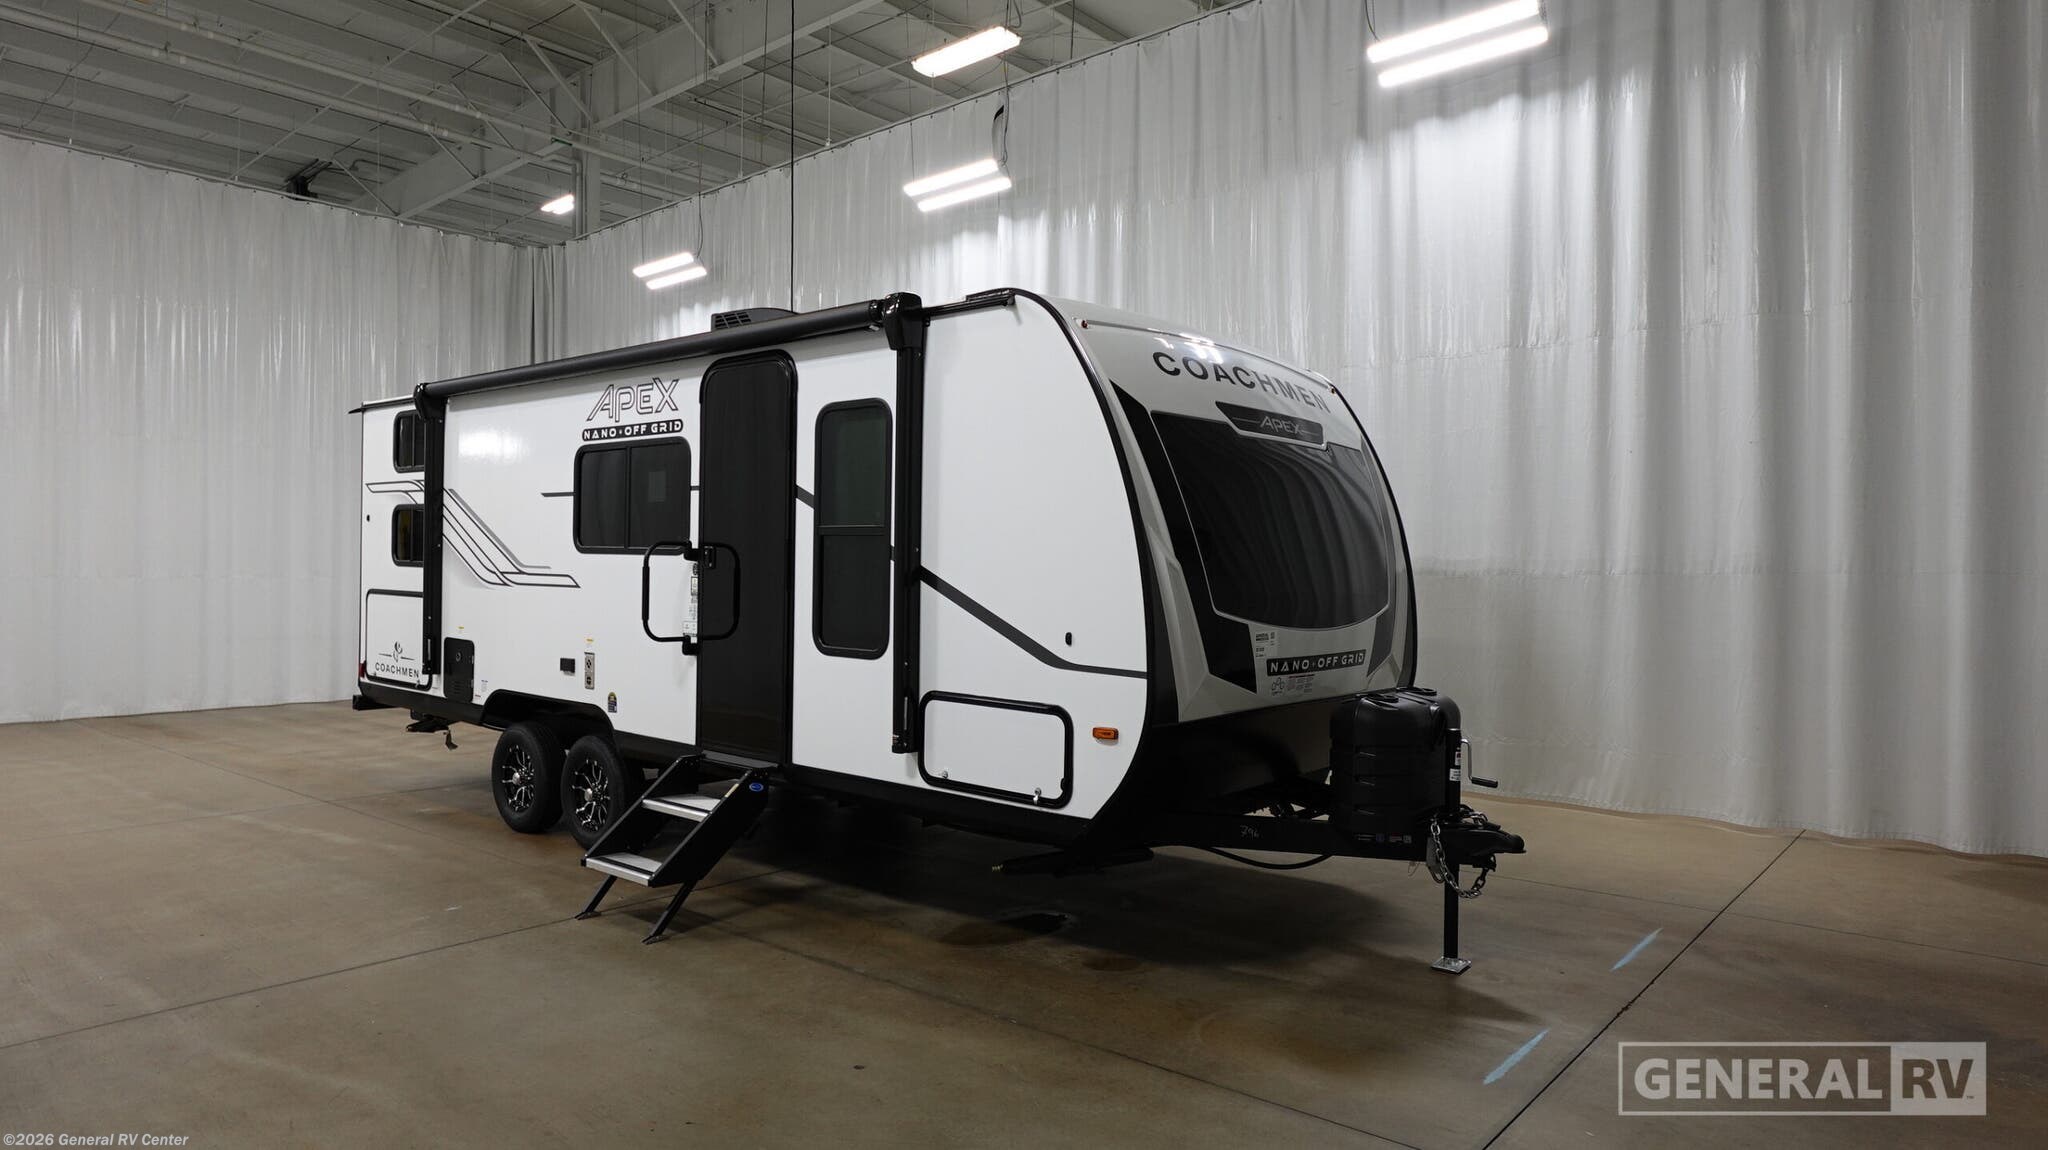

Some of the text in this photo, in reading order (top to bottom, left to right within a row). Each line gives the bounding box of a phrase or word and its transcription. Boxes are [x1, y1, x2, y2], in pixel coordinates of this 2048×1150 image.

[1152, 352, 1331, 413] COACHMEN
[586, 377, 680, 422] APEX
[651, 420, 682, 433] GRID
[1260, 415, 1302, 435] APEX
[1341, 652, 1364, 665] GRID
[375, 662, 419, 678] COACHMEN
